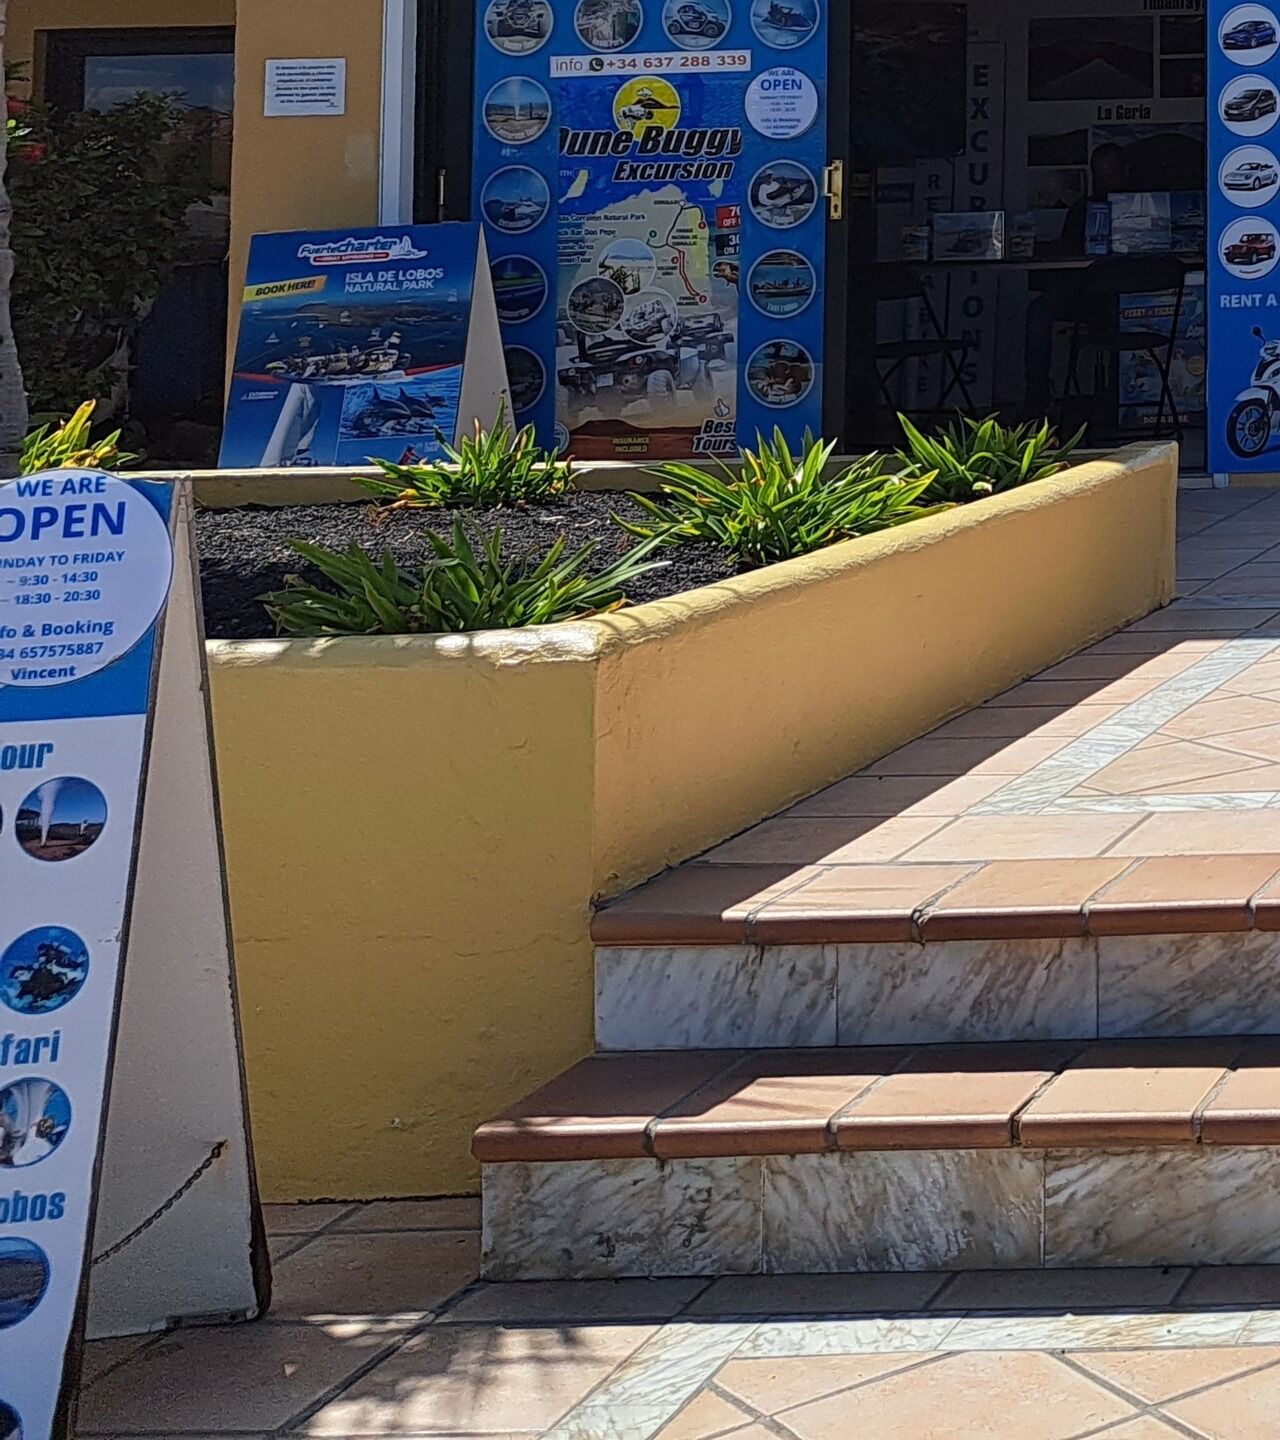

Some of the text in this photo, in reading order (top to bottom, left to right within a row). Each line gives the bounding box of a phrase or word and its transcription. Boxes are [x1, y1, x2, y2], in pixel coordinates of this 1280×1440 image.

[556, 55, 747, 72] info +34 637 288 339
[760, 78, 803, 91] OPEN
[638, 125, 742, 156] Buggy
[612, 160, 735, 182] Excursion
[346, 268, 444, 283] ISLA DE LOBOS
[255, 280, 316, 296] BOOK HERE!
[345, 279, 434, 293] NATURAL PARK
[1220, 293, 1262, 308] RENT
[1266, 293, 1277, 307] A
[16, 476, 107, 497] WE ARE
[0, 501, 126, 542] OPEN
[0, 550, 125, 569] NDAY TO FRIDAY
[61, 571, 98, 583] 14:30
[14, 592, 51, 605] 18:30
[62, 589, 100, 602] 20:30
[22, 624, 35, 637] &
[41, 621, 114, 636] Booking
[20, 642, 104, 659] 657575887
[11, 666, 76, 680] Vincent
[1, 743, 54, 770] our
